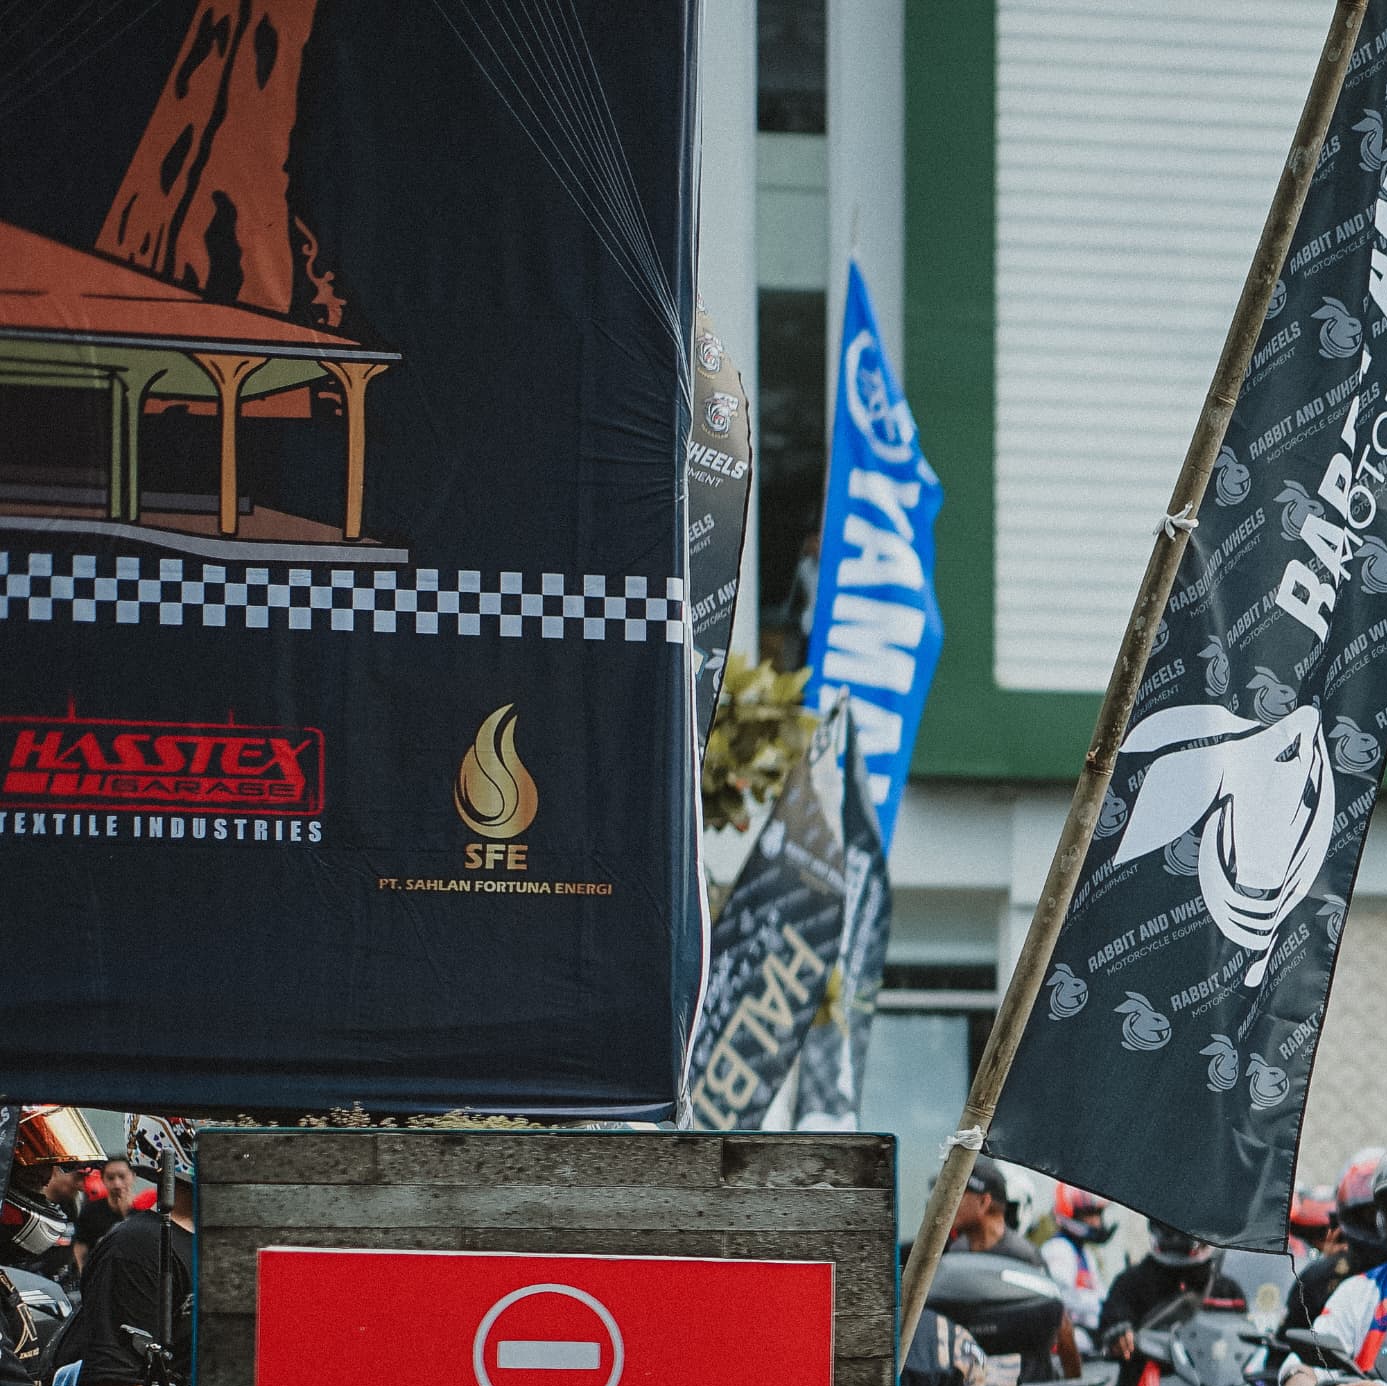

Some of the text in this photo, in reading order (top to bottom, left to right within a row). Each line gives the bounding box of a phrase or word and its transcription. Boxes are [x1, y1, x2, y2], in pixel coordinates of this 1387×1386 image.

[1289, 216, 1366, 277] RABBIT AND
[1254, 320, 1301, 369] WHEELS
[1250, 415, 1295, 460] RABBIT
[1296, 396, 1325, 429] AND
[1222, 507, 1266, 558] WHEELS
[1226, 604, 1262, 649] RABBIT
[1346, 632, 1369, 666] AND
[9, 730, 312, 776] HASSTEX
[133, 816, 323, 842] INDUSTRIES
[465, 844, 528, 870] SFE
[379, 879, 613, 895] PT. SAHLAN FORTUNA ENERGI
[1088, 929, 1138, 975] RABBIT
[1139, 912, 1169, 943] AND
[1106, 934, 1171, 976] MOTORCYCLE
[1269, 922, 1310, 976] WHEELS
[1170, 973, 1221, 1013] RABBIT
